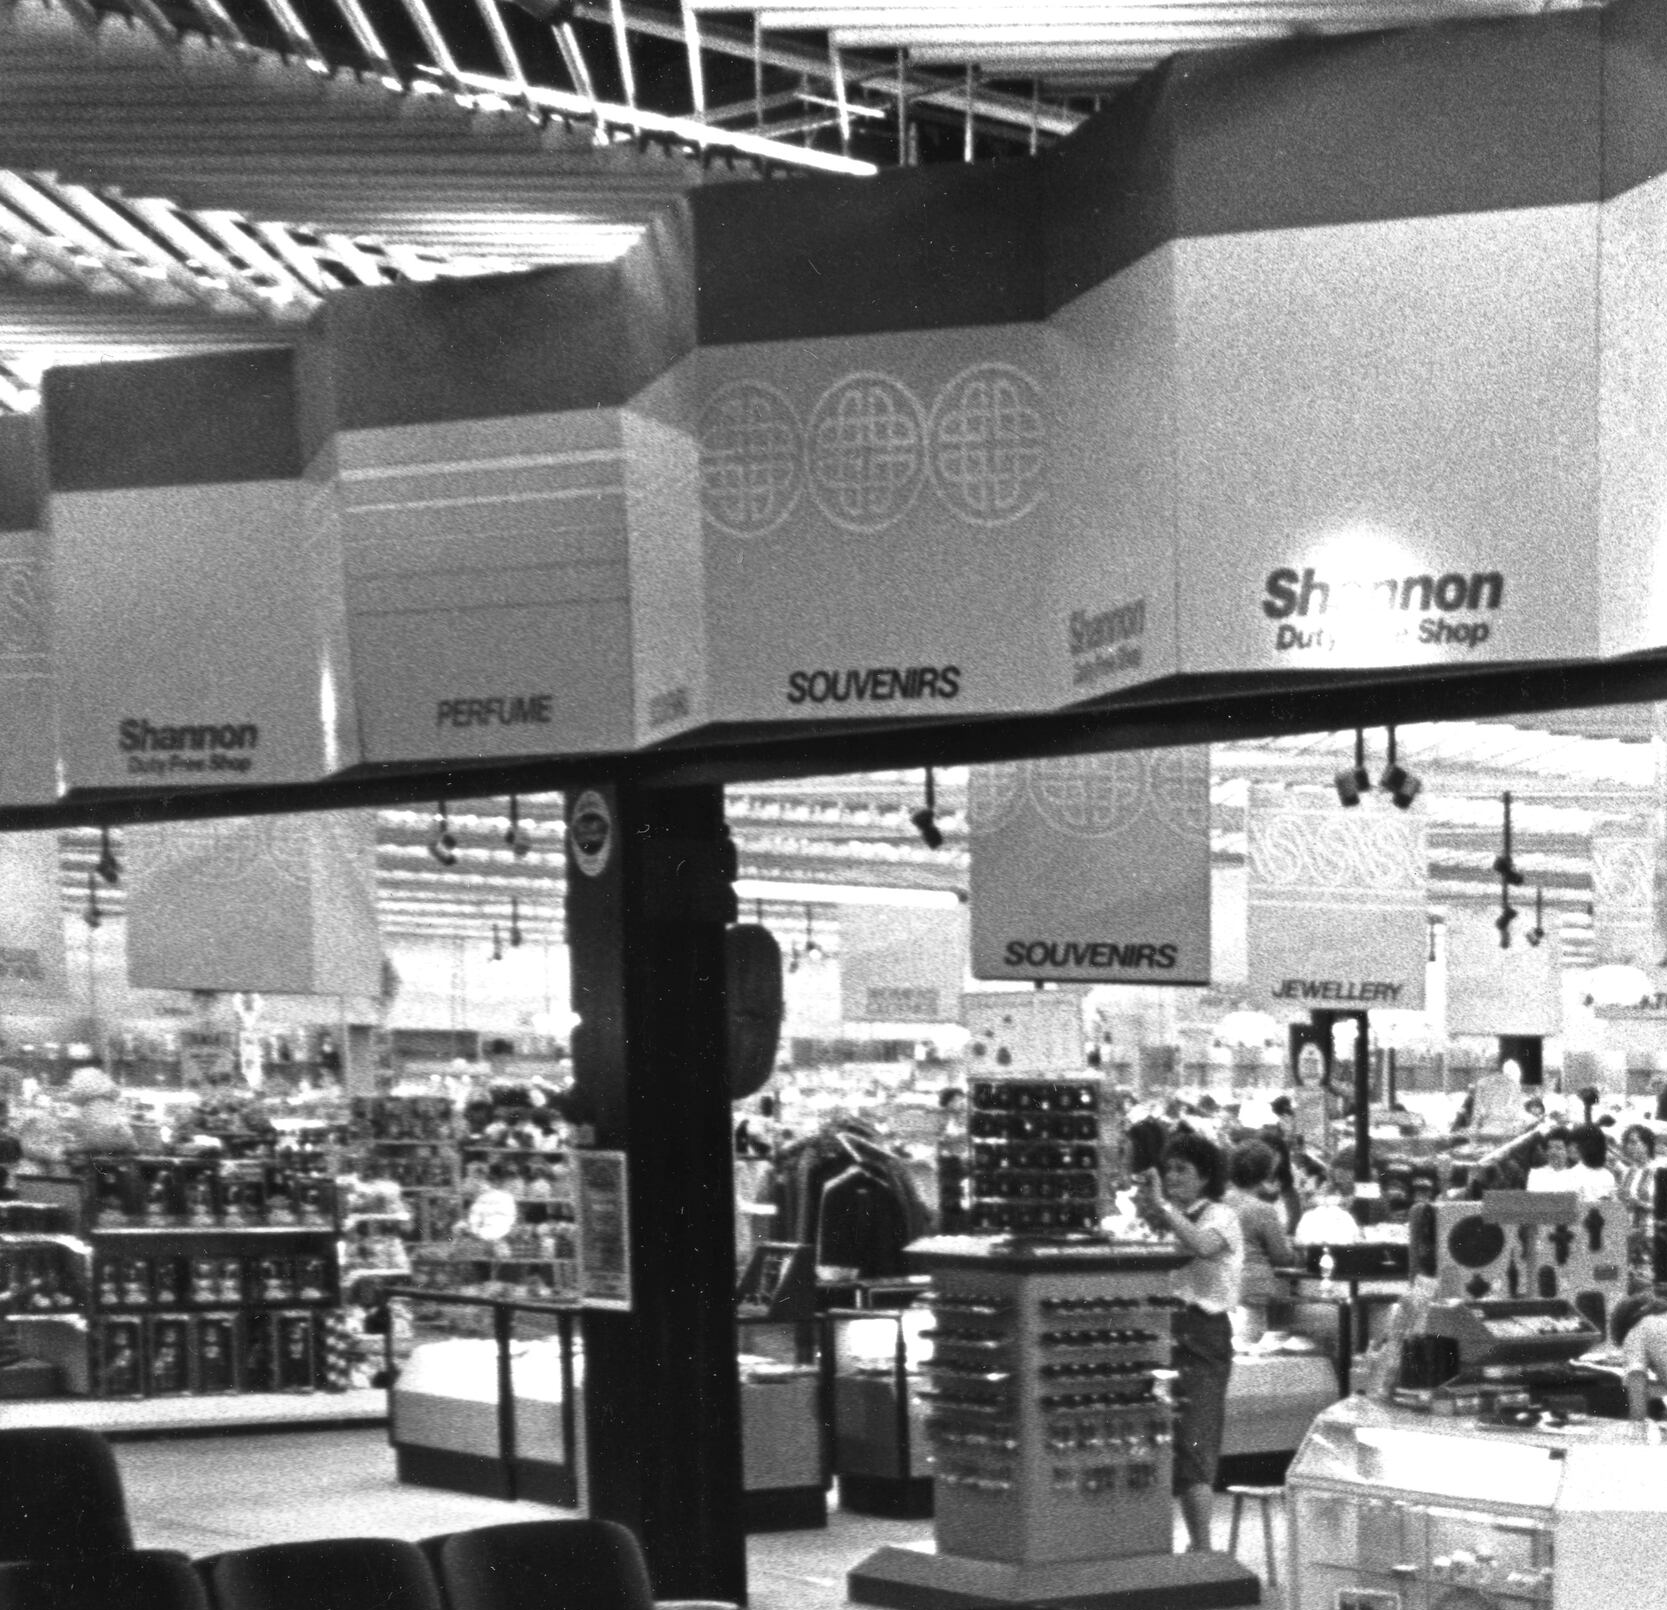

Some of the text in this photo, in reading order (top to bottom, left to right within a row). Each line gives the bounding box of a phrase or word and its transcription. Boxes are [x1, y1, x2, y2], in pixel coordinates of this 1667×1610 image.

[1418, 617, 1490, 648] Shop
[786, 665, 961, 704] SOUVENIRS
[436, 695, 553, 729] PERFUME
[118, 718, 259, 753] Shannon
[208, 753, 252, 773] Shop
[1004, 940, 1178, 969] SOUVENIRS
[1272, 979, 1400, 1001] JEWELLERY
